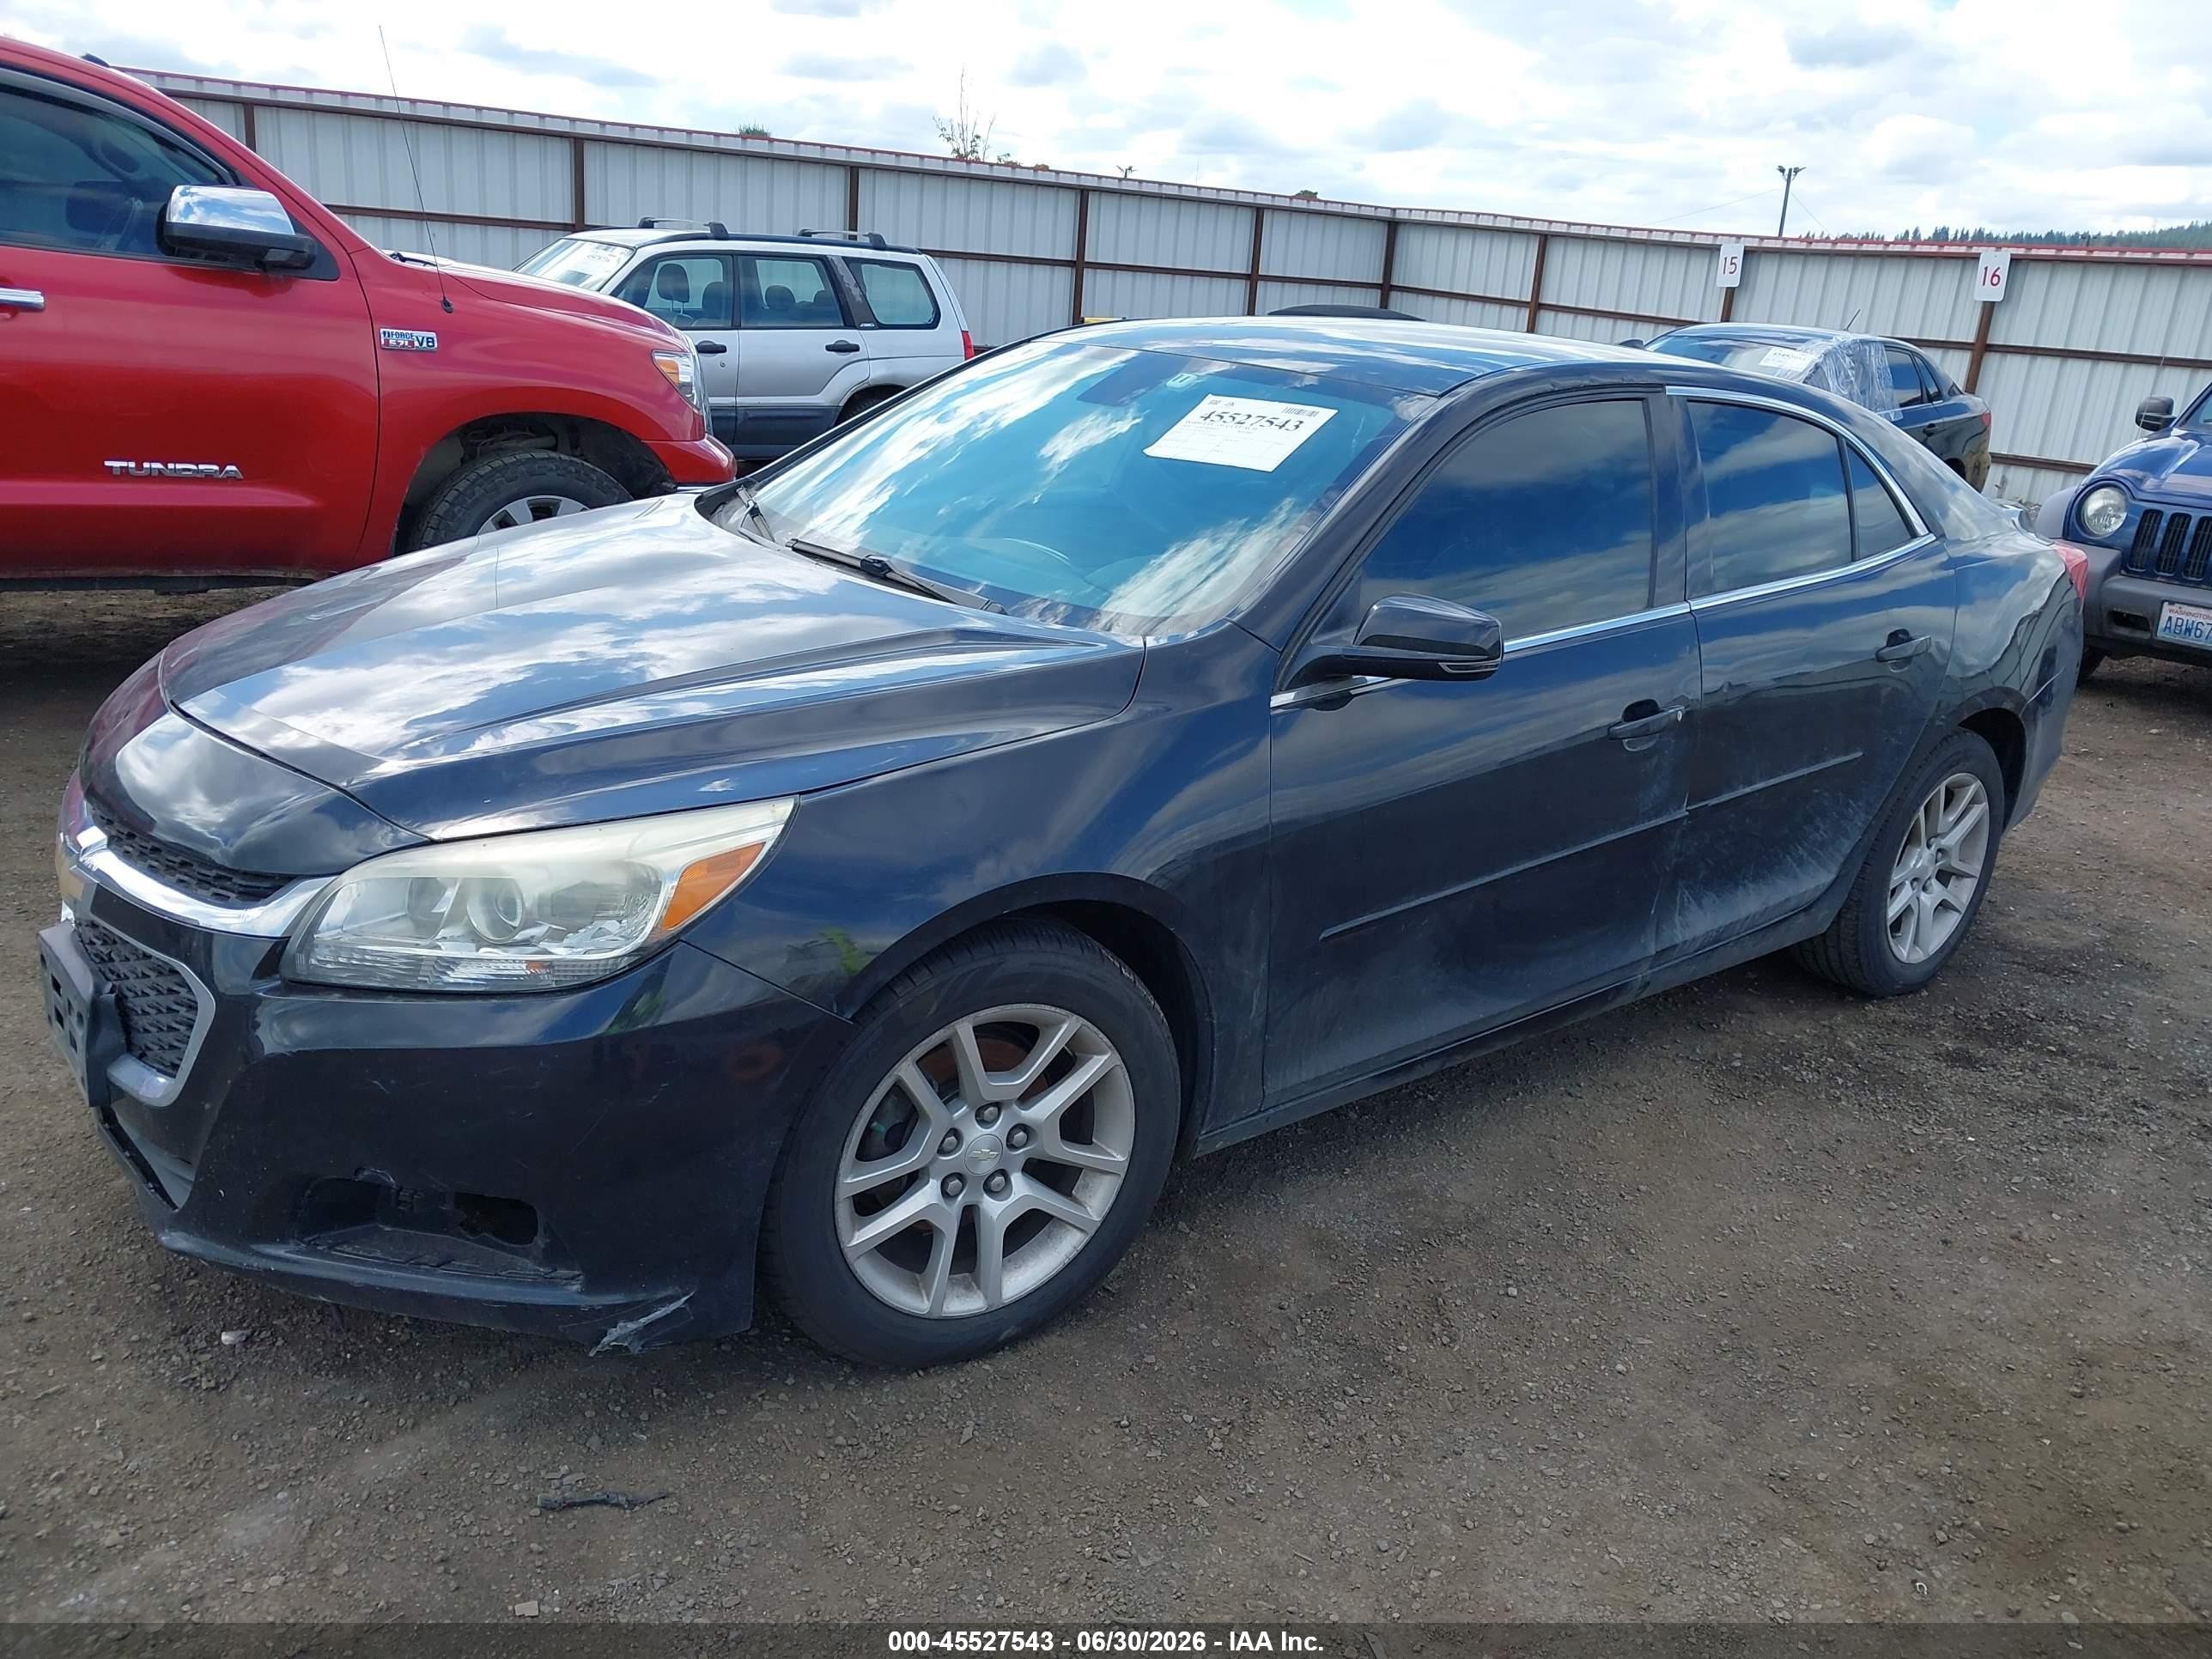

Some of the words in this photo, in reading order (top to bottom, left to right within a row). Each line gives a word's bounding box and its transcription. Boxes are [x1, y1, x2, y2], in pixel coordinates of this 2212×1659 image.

[1723, 256, 1738, 275] 15
[1982, 265, 2001, 286] 16
[415, 336, 435, 348] V8
[1200, 410, 1304, 432] 45527543
[104, 460, 244, 479] TUNDRA
